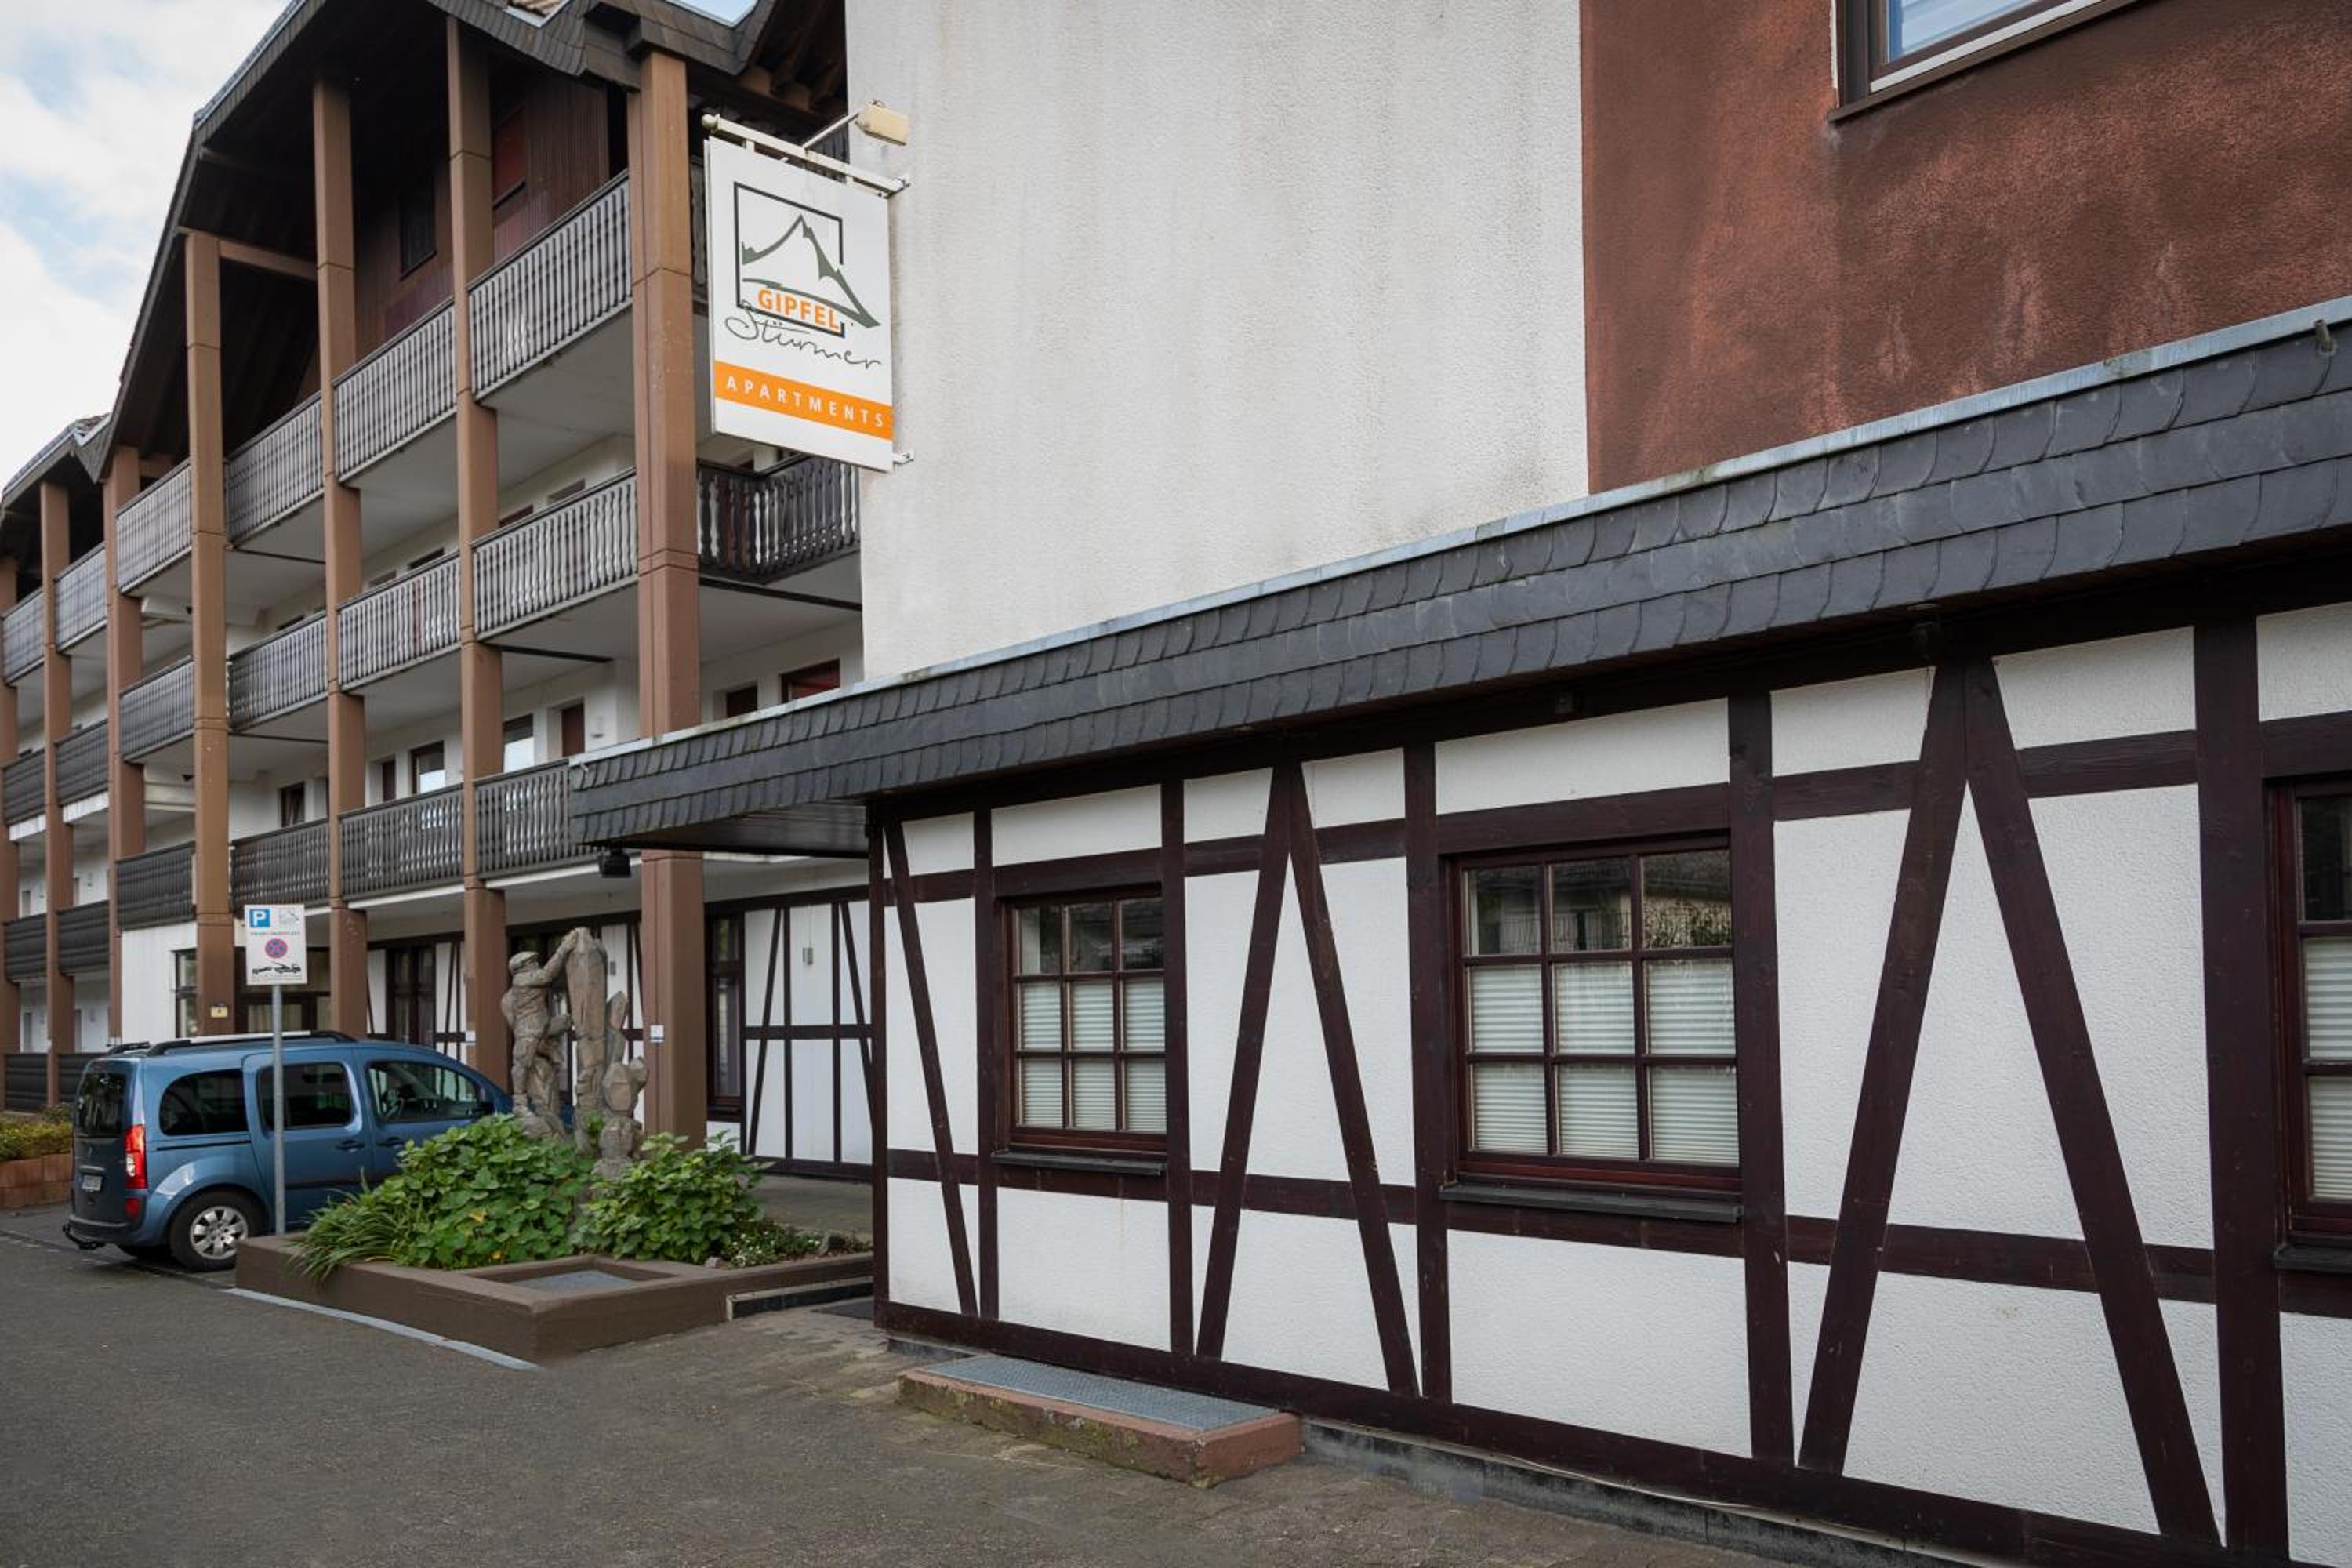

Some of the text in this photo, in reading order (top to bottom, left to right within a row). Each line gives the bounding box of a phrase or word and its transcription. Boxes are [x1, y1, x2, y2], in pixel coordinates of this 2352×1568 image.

[757, 287, 839, 330] GIPFEL
[726, 376, 884, 427] APARTMENTS
[253, 911, 266, 926] P
